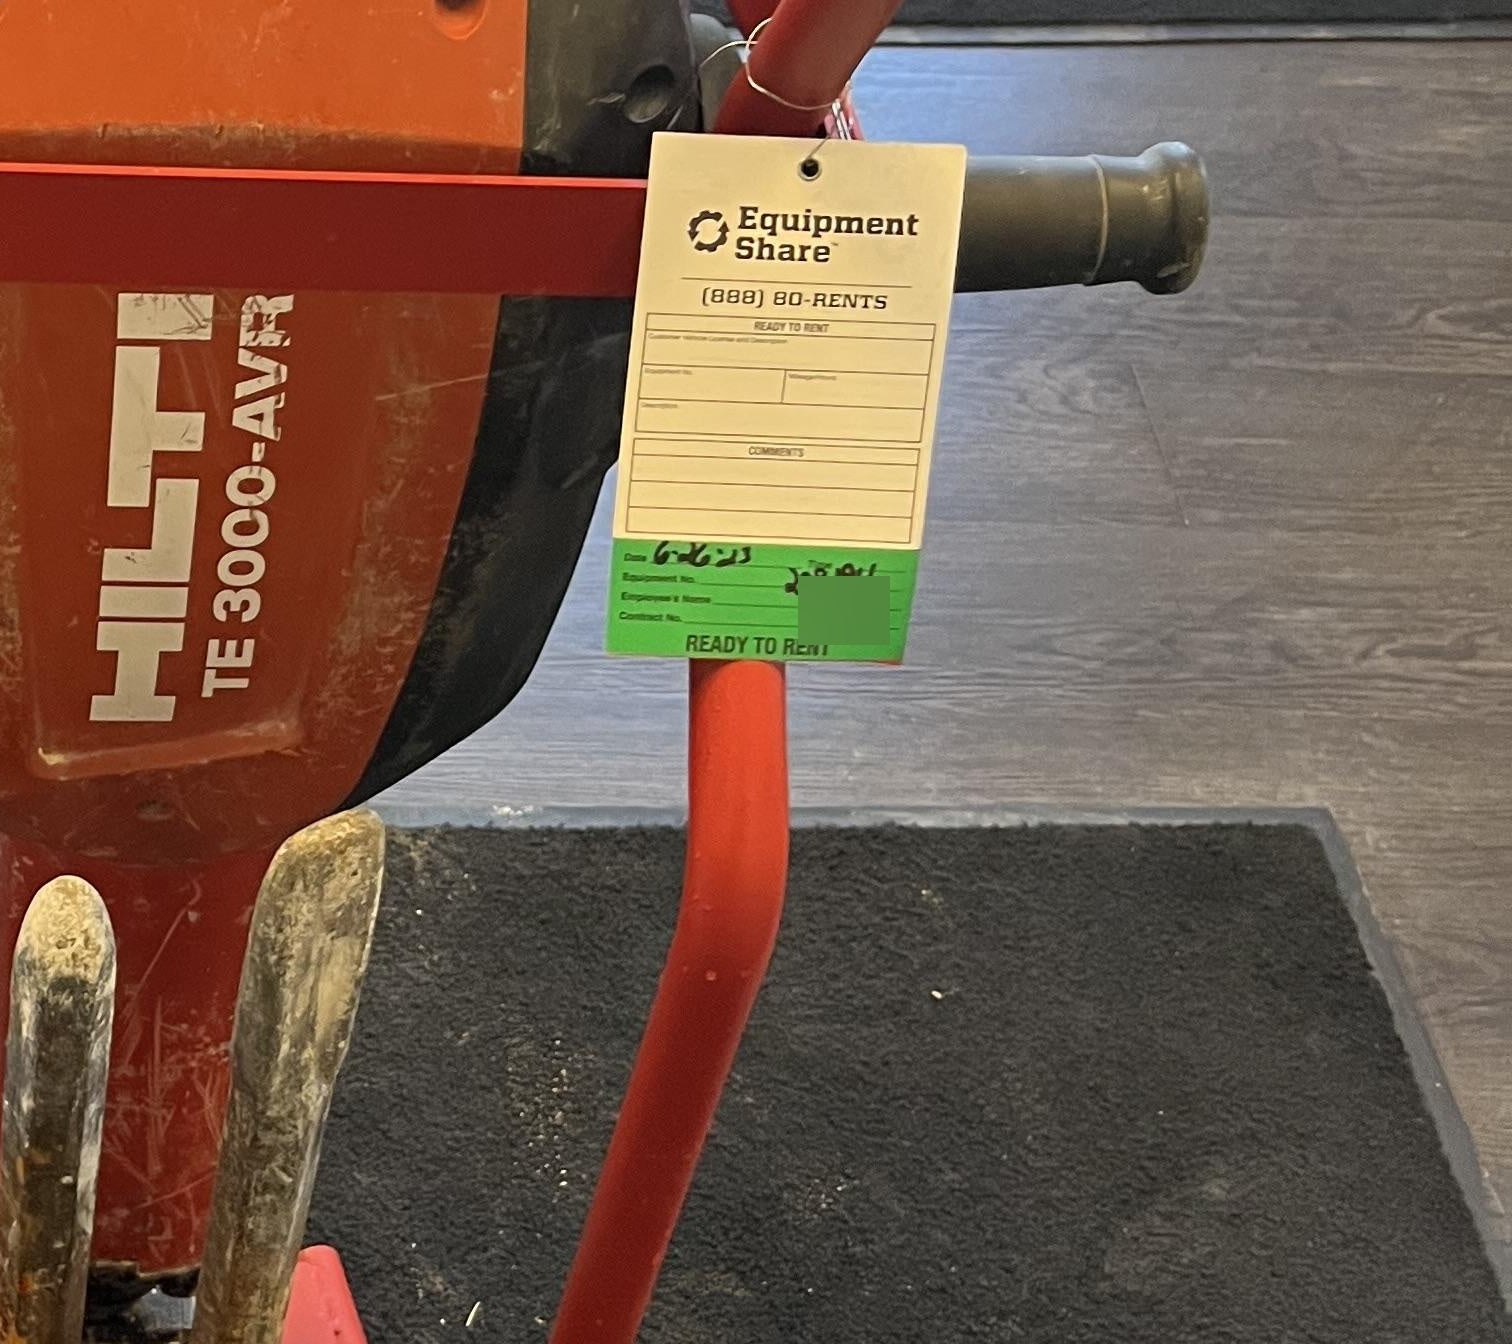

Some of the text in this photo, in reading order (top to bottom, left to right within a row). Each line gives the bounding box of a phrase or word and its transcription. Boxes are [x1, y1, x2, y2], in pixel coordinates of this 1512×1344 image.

[738, 206, 919, 237] Equipment
[735, 237, 830, 262] Share
[701, 287, 888, 310] (888) 80-RENTS
[754, 321, 830, 333] READY TO RENT
[89, 293, 213, 721] HILTI
[201, 294, 294, 697] TE 3000-AVR
[686, 634, 748, 654] READY
[753, 636, 777, 655] TO
